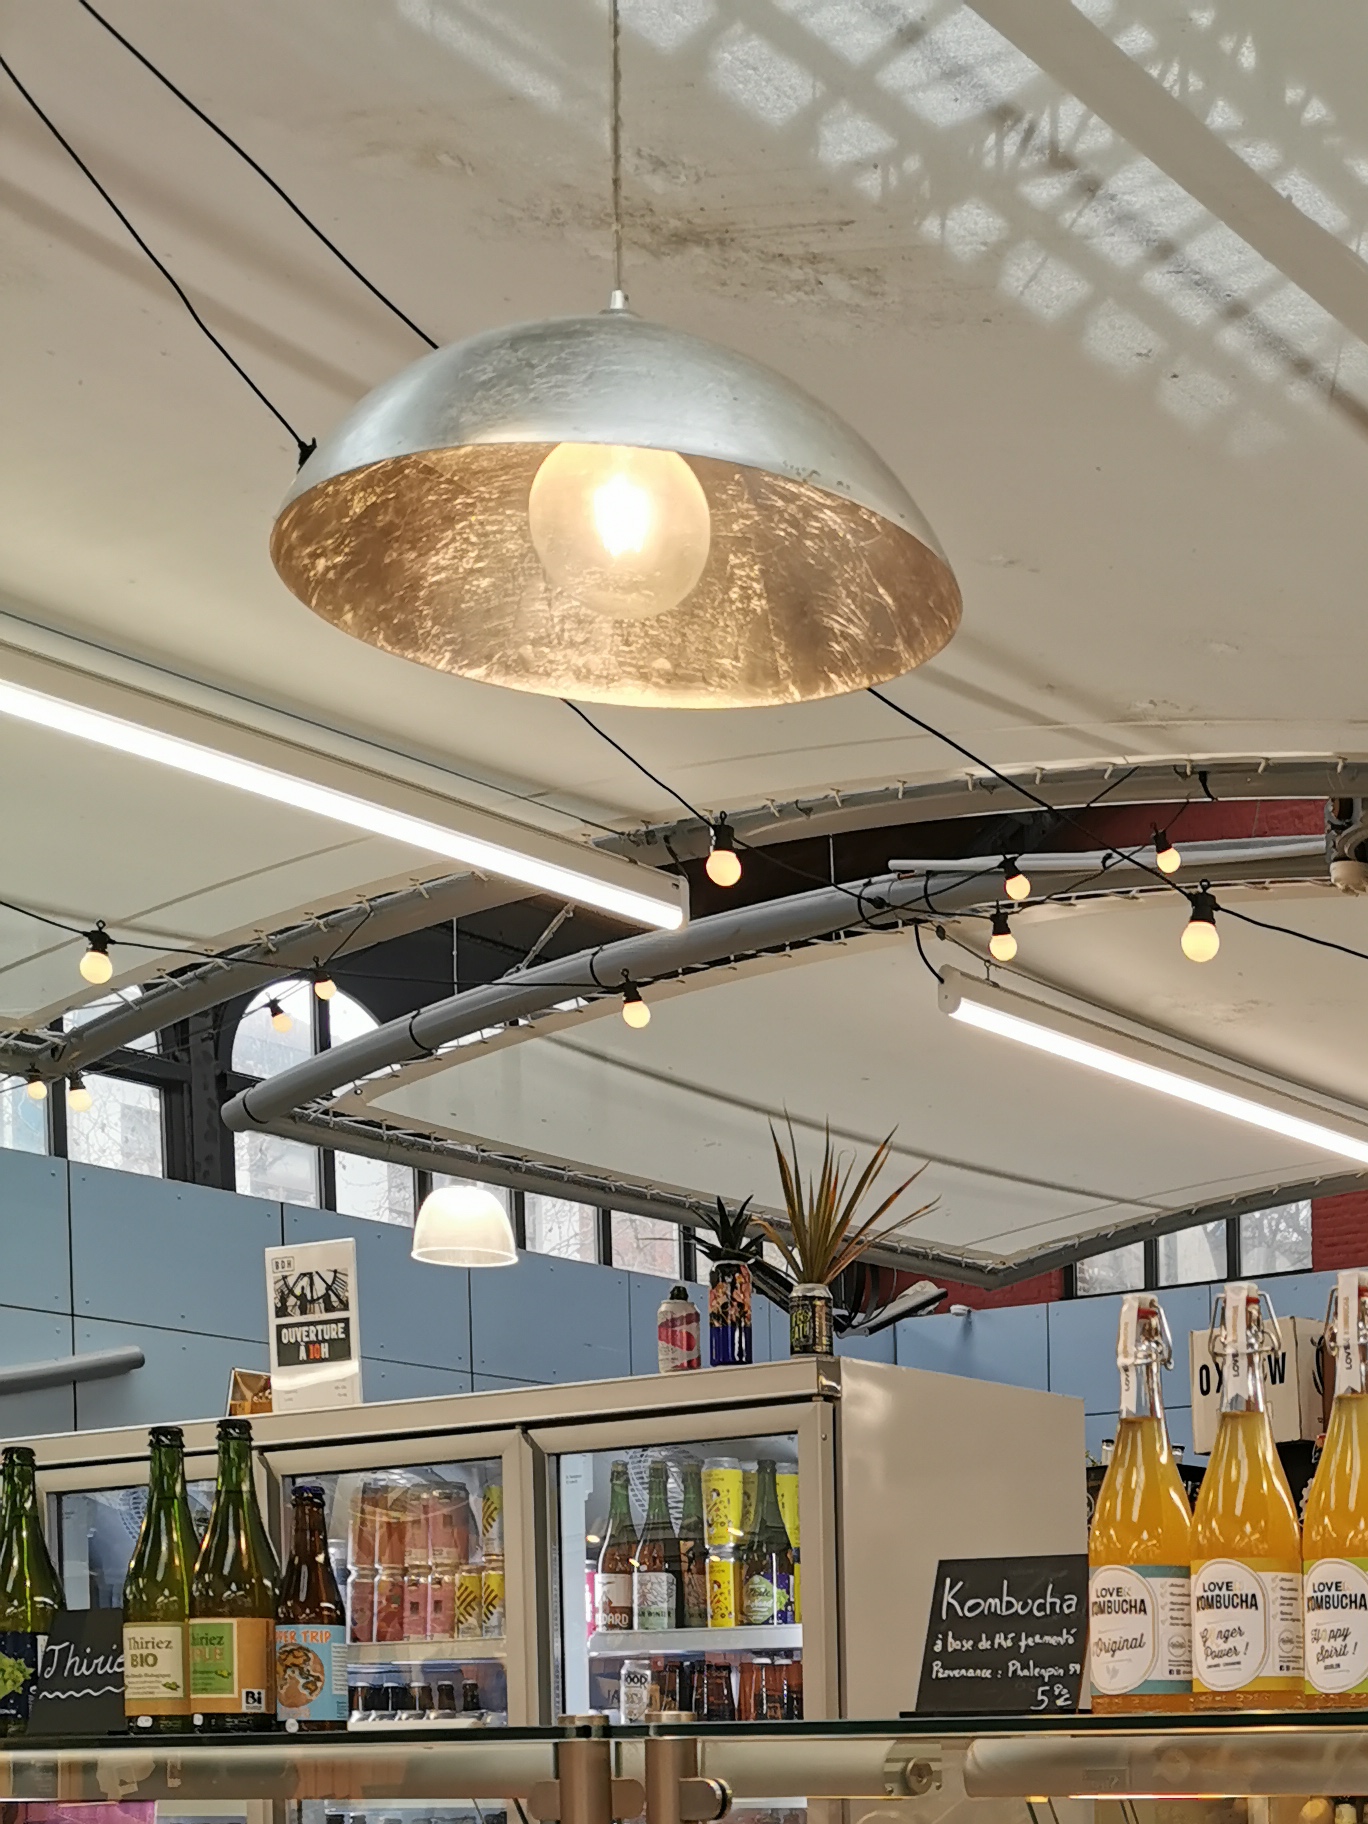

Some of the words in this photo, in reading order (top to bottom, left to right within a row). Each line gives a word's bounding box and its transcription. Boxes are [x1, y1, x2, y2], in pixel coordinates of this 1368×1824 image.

[281, 1322, 346, 1344] OUVERTURE
[1199, 1350, 1287, 1396] OXW
[941, 1577, 1078, 1620] Kombucha
[1196, 1593, 1259, 1613] KOMBUCHA
[1306, 1593, 1368, 1613] KOMBUCHA
[128, 1637, 174, 1651] Thiriez
[301, 1629, 332, 1643] TRIP
[947, 1630, 974, 1652] base
[978, 1633, 991, 1650] de
[44, 1641, 125, 1679] Thirie
[130, 1652, 158, 1668] BIO
[1204, 1645, 1241, 1662] Power
[1316, 1642, 1349, 1665] Spirit
